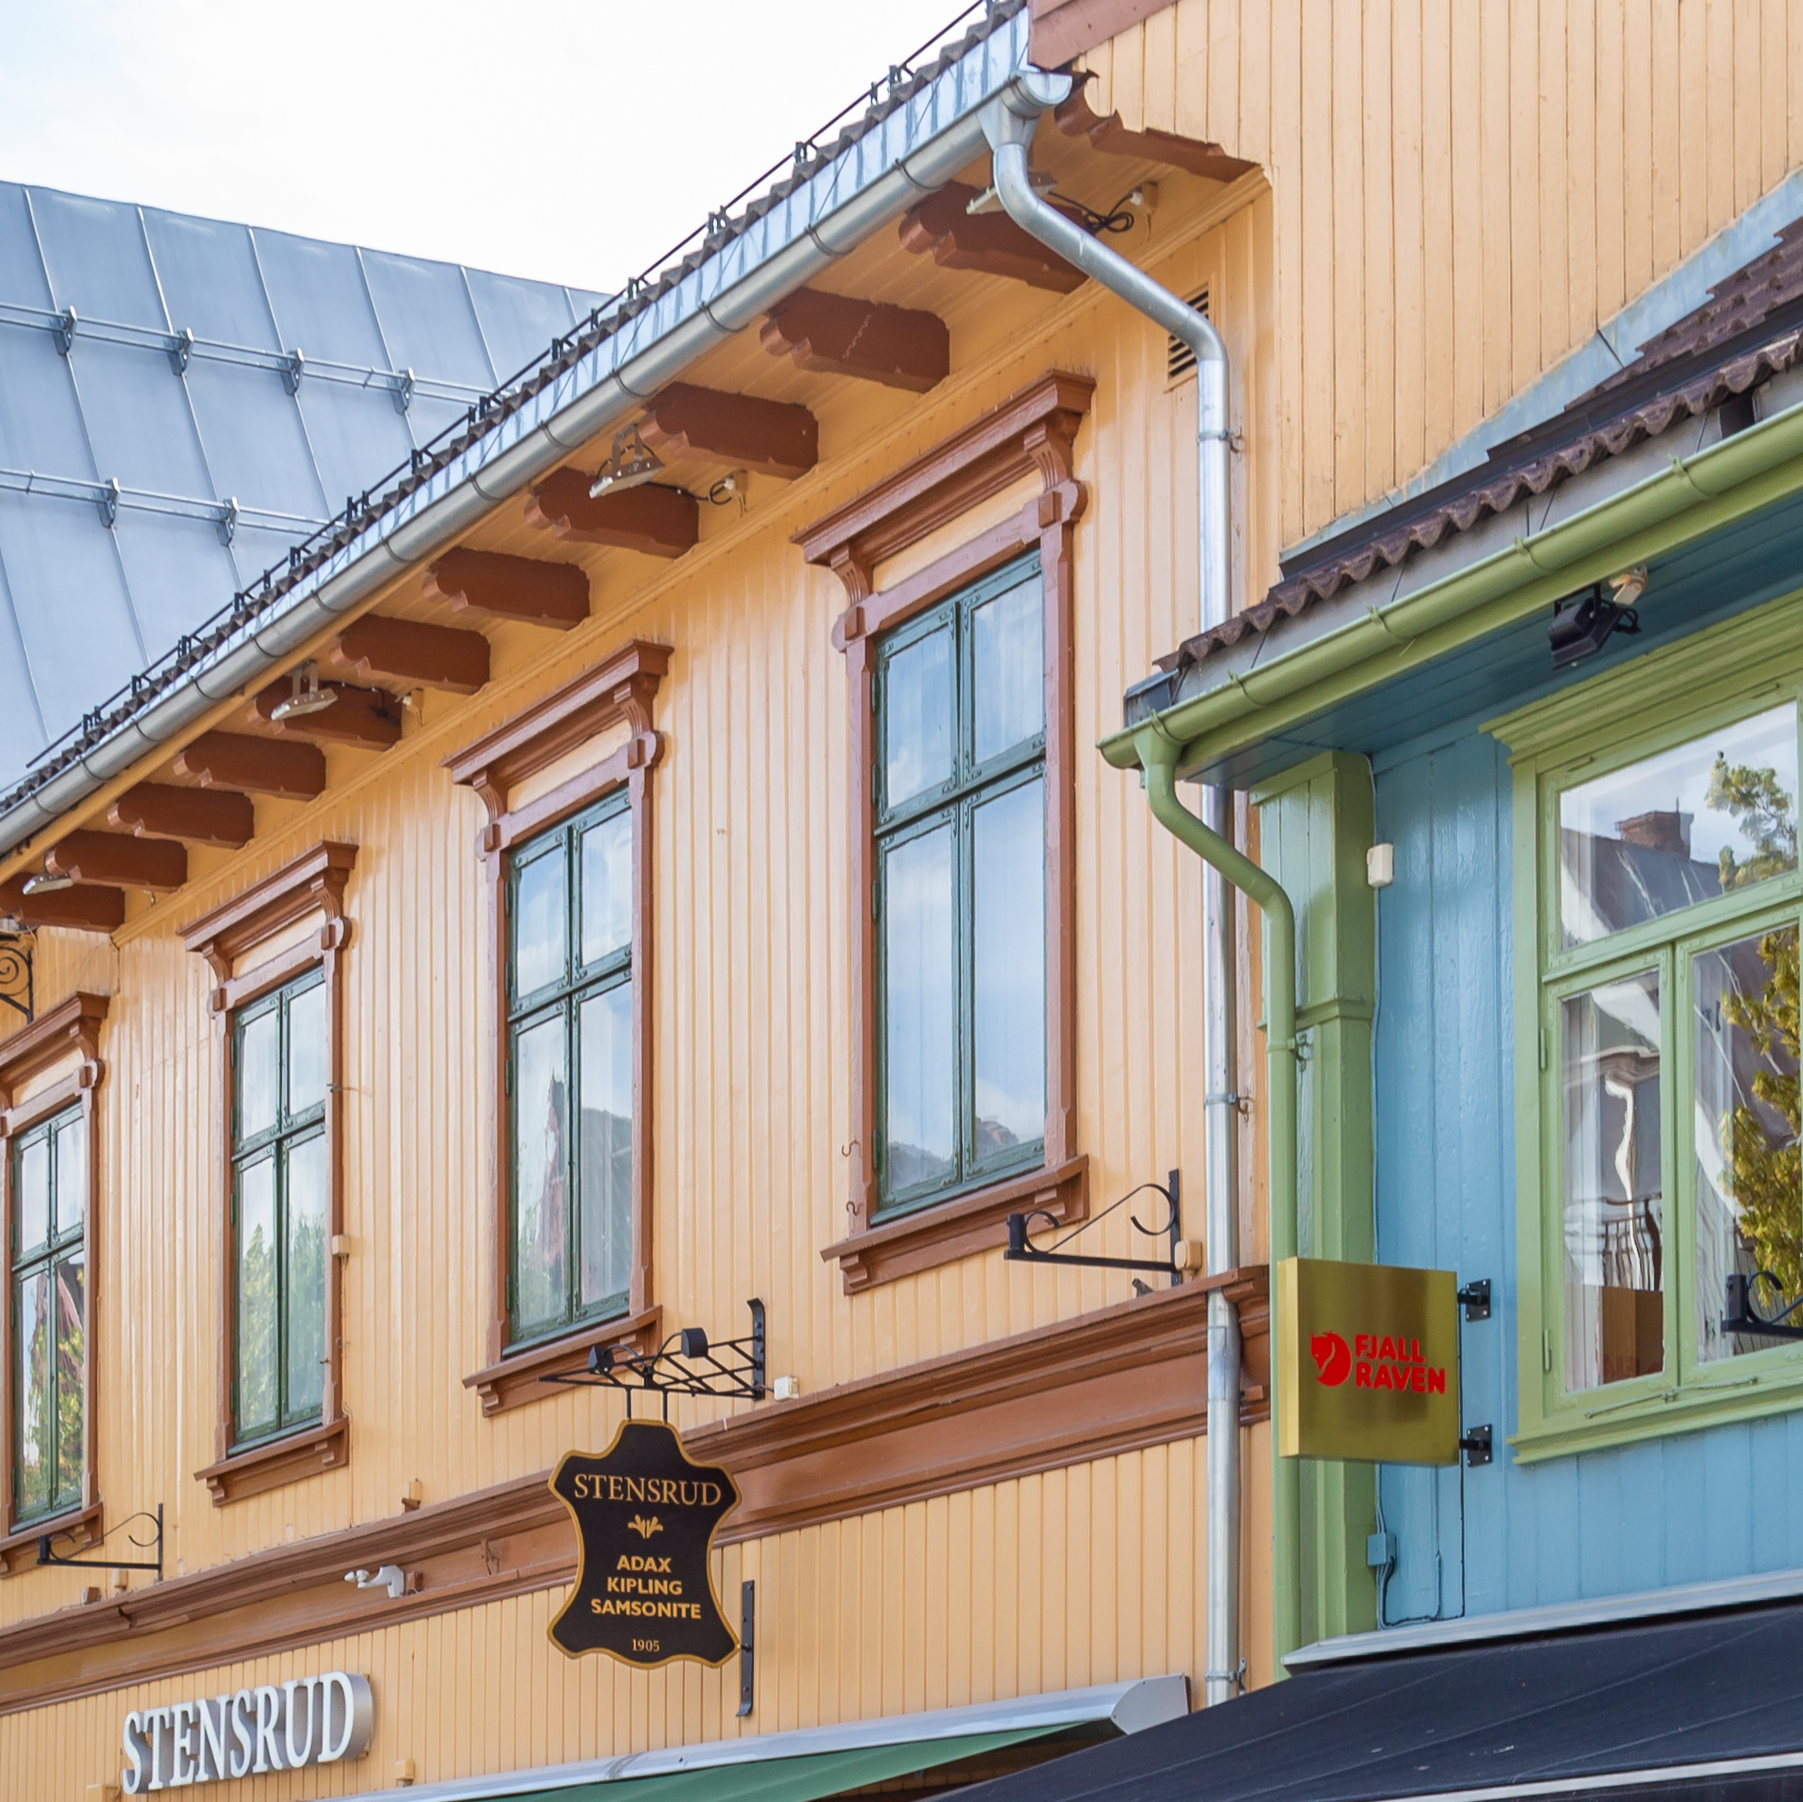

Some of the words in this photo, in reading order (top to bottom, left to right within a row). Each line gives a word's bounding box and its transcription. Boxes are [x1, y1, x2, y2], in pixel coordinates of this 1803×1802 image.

[574, 1474, 721, 1506] STENSRUD
[617, 1555, 671, 1573] ADAX
[607, 1577, 682, 1595] KIPLING
[591, 1599, 701, 1619] SAMSONITE
[632, 1639, 659, 1652] 1905
[123, 1671, 358, 1795] STENSRUD
